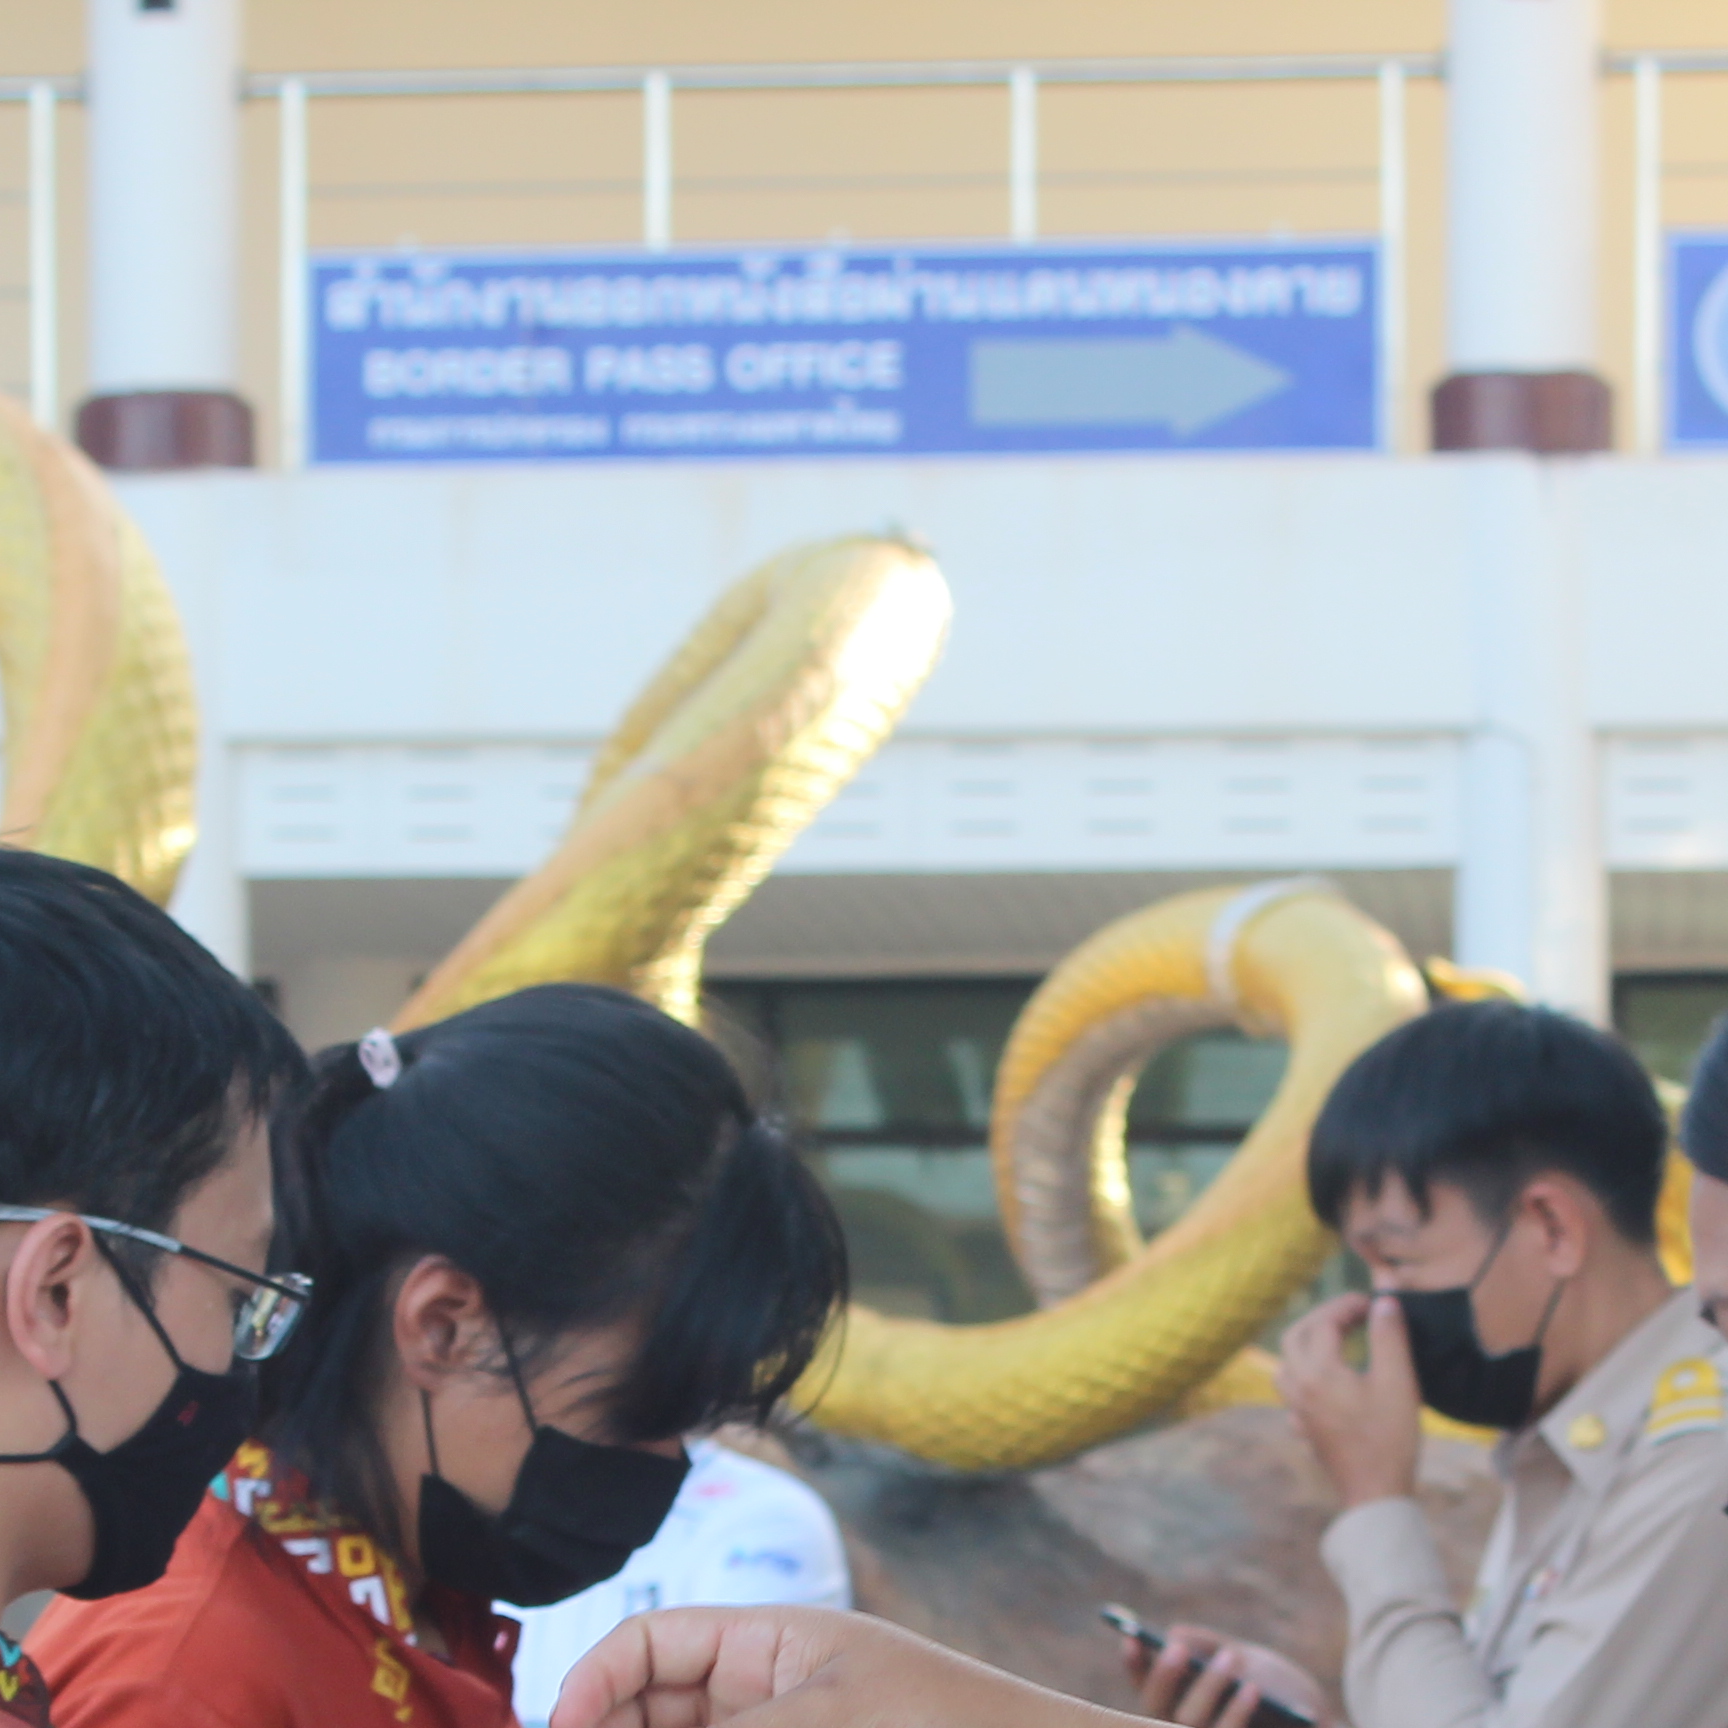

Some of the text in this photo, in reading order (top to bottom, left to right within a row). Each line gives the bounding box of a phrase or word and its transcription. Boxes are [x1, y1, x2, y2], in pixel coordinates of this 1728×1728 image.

[364, 339, 902, 398] BORDER PASS OFFICE
